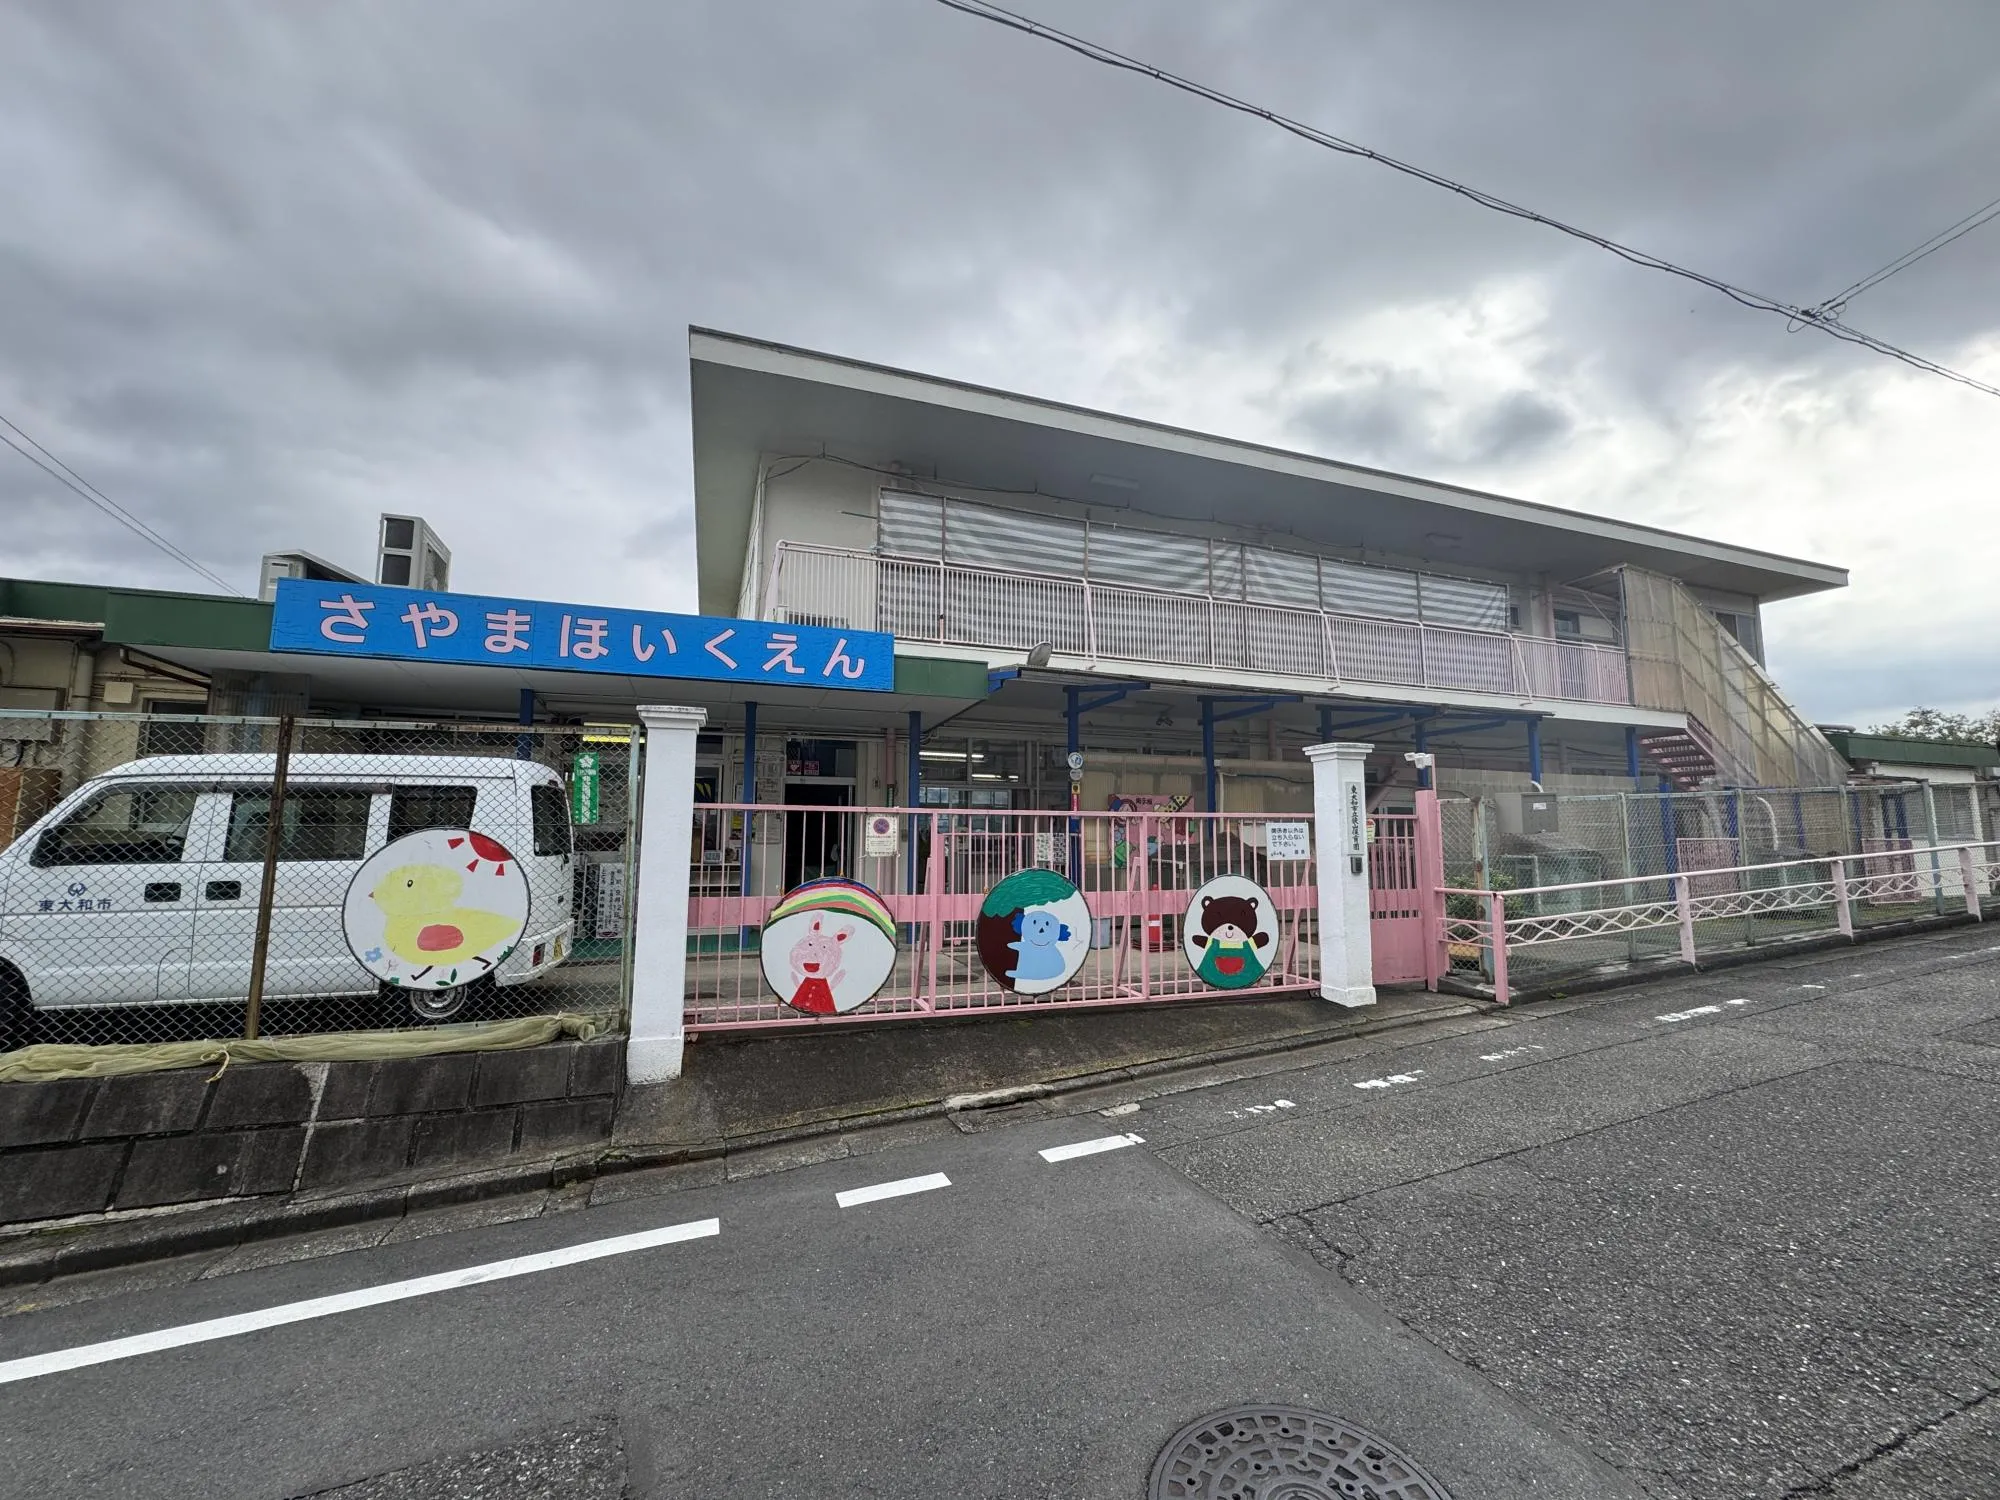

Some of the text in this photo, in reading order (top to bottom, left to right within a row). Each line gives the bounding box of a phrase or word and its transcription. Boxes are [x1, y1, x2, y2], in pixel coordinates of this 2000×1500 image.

[319, 594, 866, 679] さやまほいくえん
[38, 897, 112, 912] 東大和市
